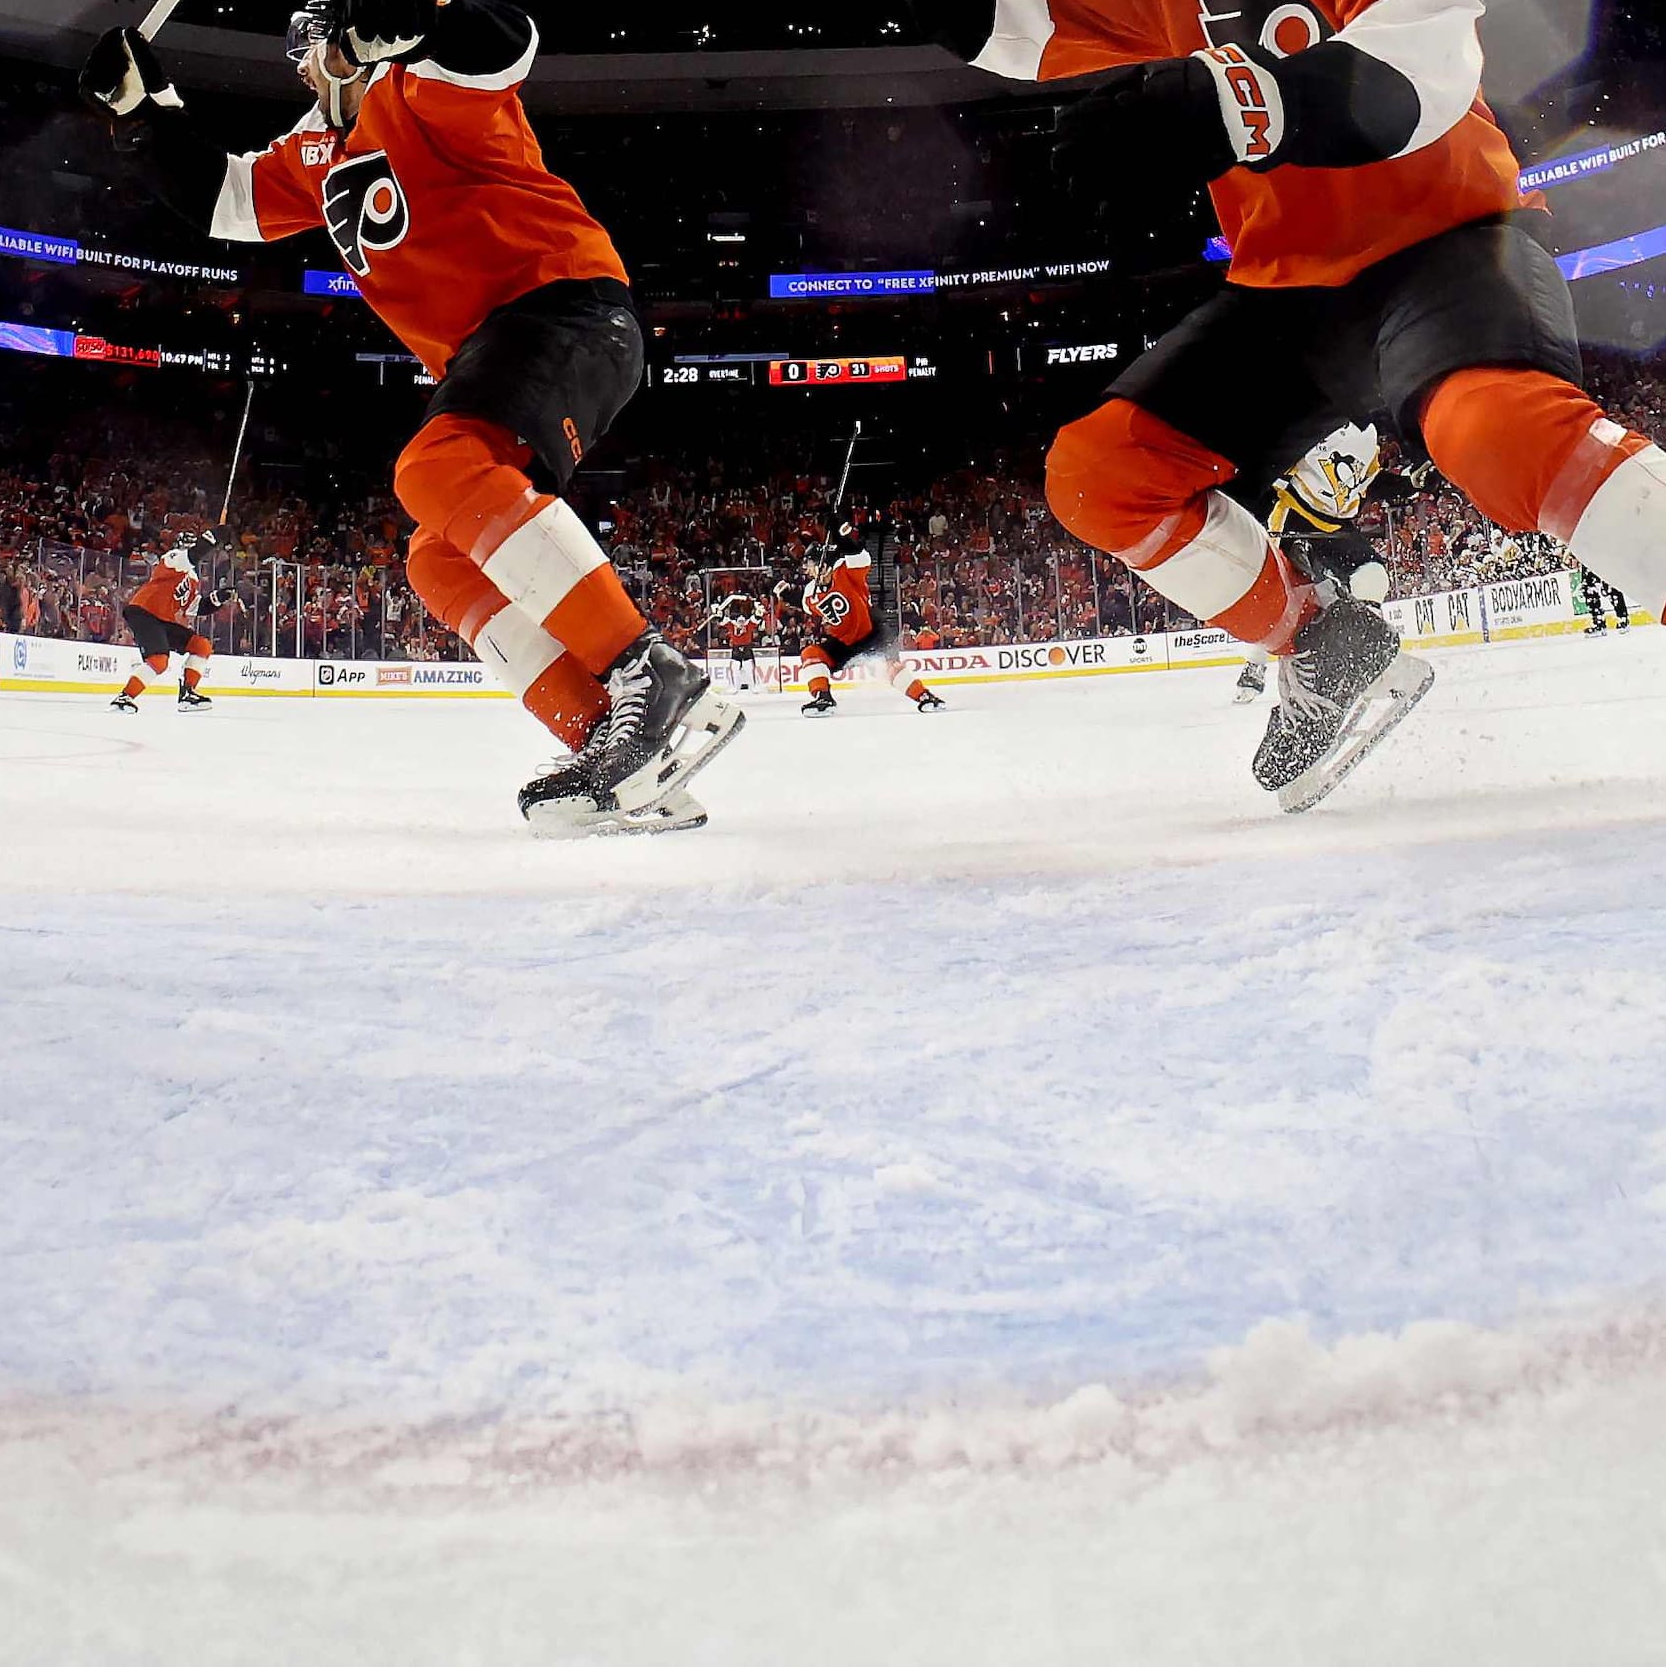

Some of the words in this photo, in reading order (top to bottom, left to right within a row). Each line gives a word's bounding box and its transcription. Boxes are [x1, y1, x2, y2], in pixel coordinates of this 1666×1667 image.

[301, 143, 335, 166] IBX
[1519, 160, 1579, 189] RELIABLE
[1579, 153, 1608, 171] WIFI
[1609, 140, 1642, 162] BUILT
[1642, 132, 1666, 151] FOR
[44, 242, 74, 259] WIFI
[76, 247, 112, 265] BUILT
[114, 254, 142, 270] FOR
[142, 259, 200, 278] PLAYOFF
[201, 267, 238, 282] RUNS
[788, 279, 852, 292] CONNECT
[854, 279, 873, 290] TO
[918, 274, 969, 287] XFINITY
[1045, 264, 1075, 277] WIFI
[1077, 260, 1110, 274] NOW
[187, 354, 203, 365] PM
[1046, 343, 1118, 365] FLYERS
[663, 368, 698, 383] 2:28
[788, 364, 799, 379] 0
[851, 363, 867, 375] 31
[873, 365, 899, 373] SHOTS
[1491, 577, 1561, 614] BODYARMOR
[1415, 598, 1435, 635] CAT
[1447, 592, 1470, 631] CAT
[1174, 633, 1226, 648] theScore
[903, 655, 991, 672] ONDA
[998, 643, 1106, 669] DISCOVER
[1129, 656, 1153, 664] SPORTS
[240, 661, 281, 685] Wegmans
[413, 670, 483, 684] AMAZING
